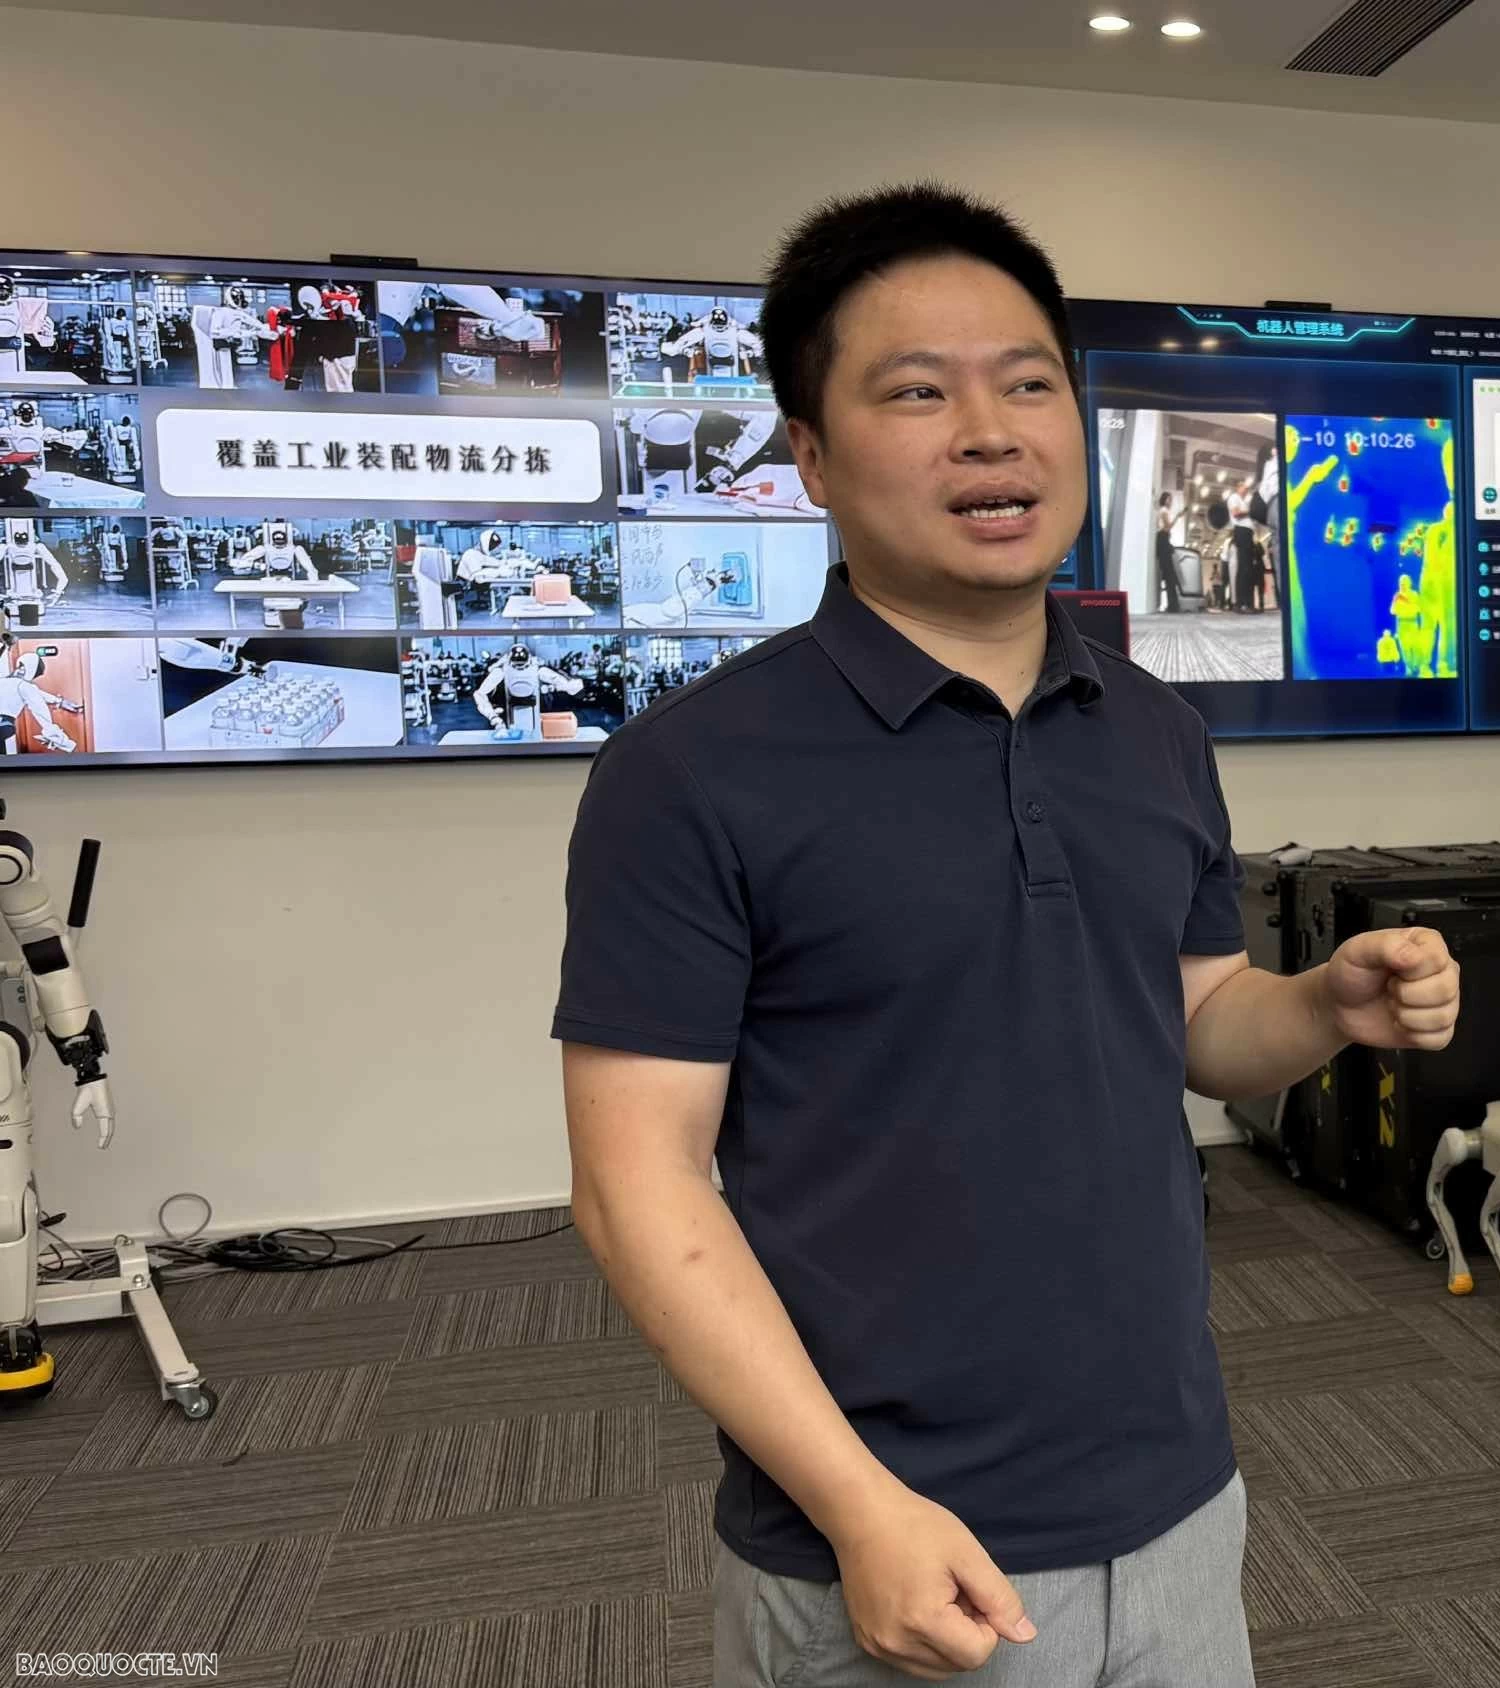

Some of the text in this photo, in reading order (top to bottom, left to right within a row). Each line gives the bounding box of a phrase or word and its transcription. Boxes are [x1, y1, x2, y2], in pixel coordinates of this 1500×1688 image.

[1256, 319, 1344, 337] 机器人管理系统
[1295, 430, 1416, 449] -10 10:10:26
[214, 438, 552, 475] 覆盖工业装配物流分拣
